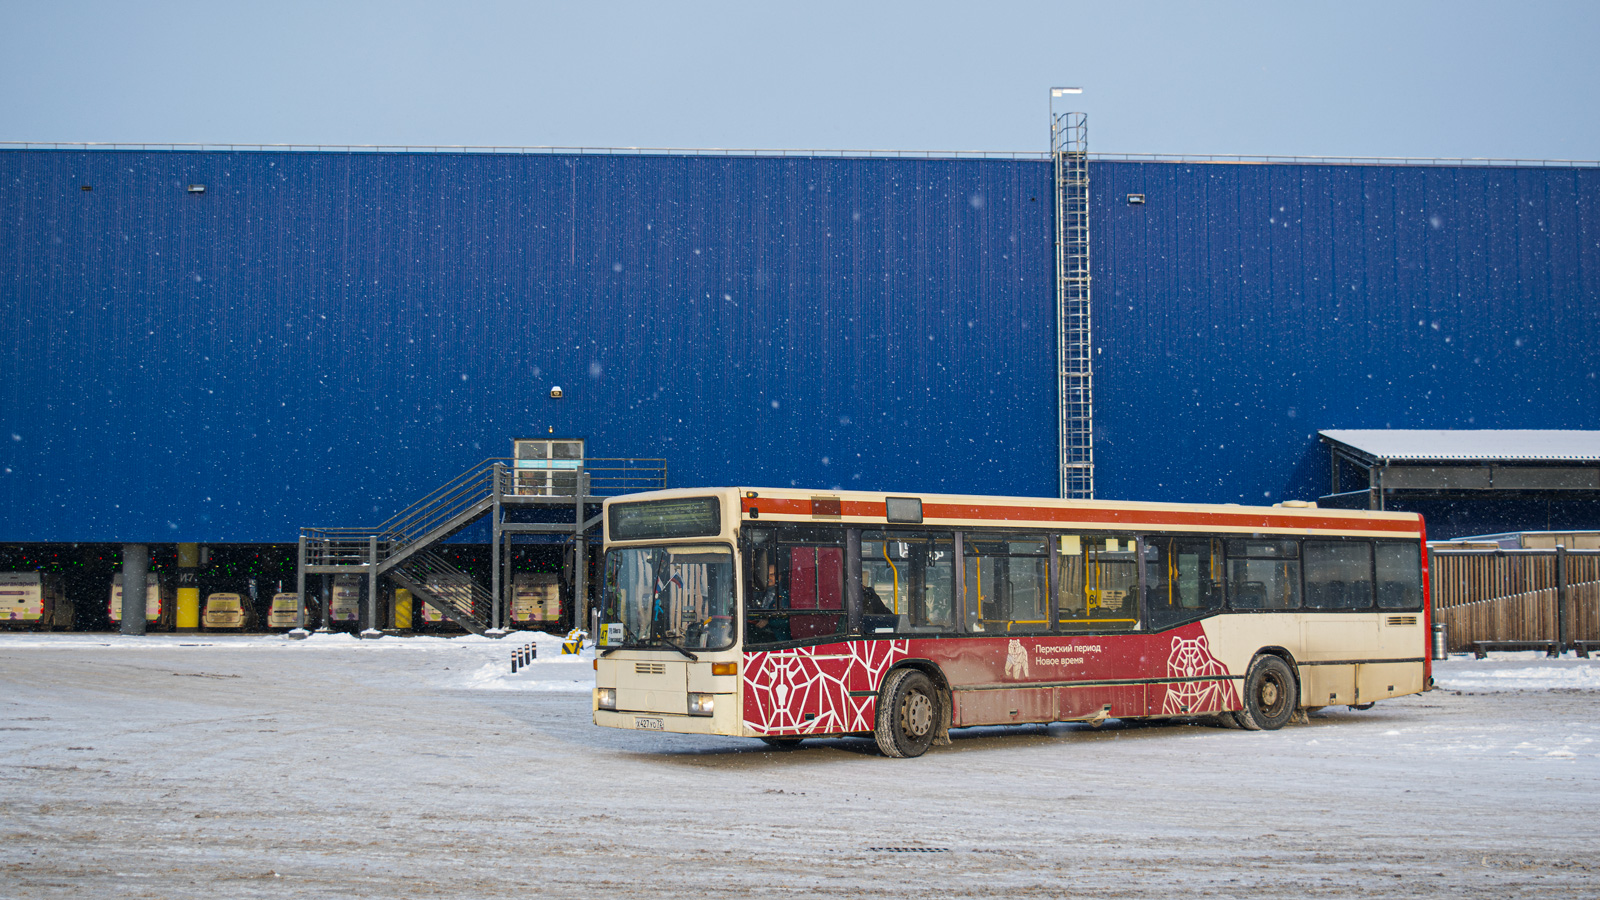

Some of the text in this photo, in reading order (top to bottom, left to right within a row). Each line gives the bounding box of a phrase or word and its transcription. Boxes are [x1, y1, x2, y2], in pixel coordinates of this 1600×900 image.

[1035, 644, 1102, 655] Пермский период
[1035, 657, 1084, 666] Новое время
